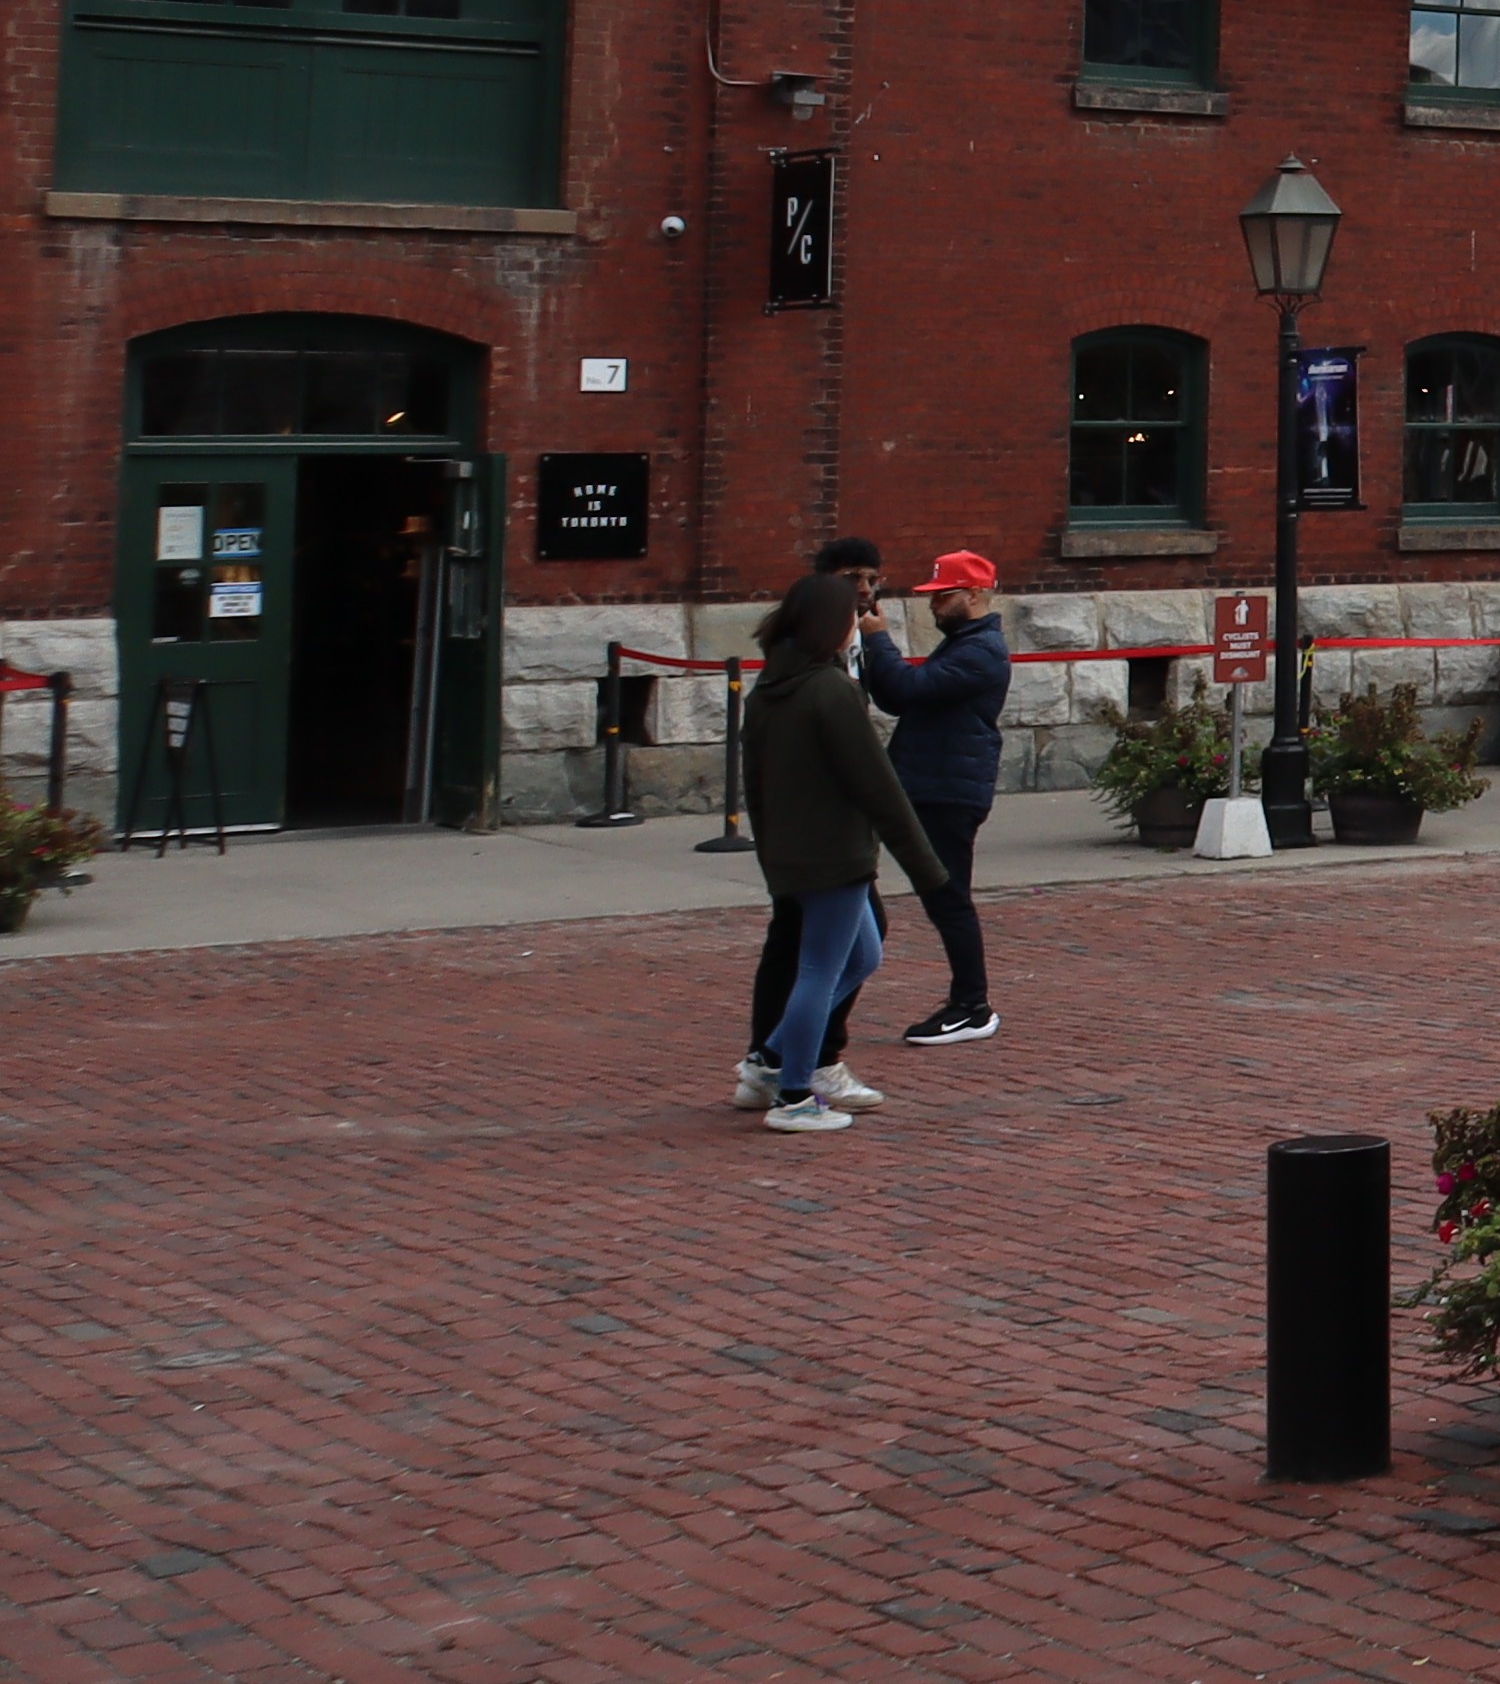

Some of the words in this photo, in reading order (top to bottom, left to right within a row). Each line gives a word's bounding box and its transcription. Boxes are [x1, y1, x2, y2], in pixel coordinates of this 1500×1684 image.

[606, 365, 621, 385] 7
[573, 484, 618, 498] HOME
[588, 501, 602, 512] IS
[561, 517, 628, 528] TORONTO
[1222, 632, 1260, 641] CYCLISTS
[1230, 642, 1252, 650] MUST
[1220, 650, 1261, 660] DISMOUNT
